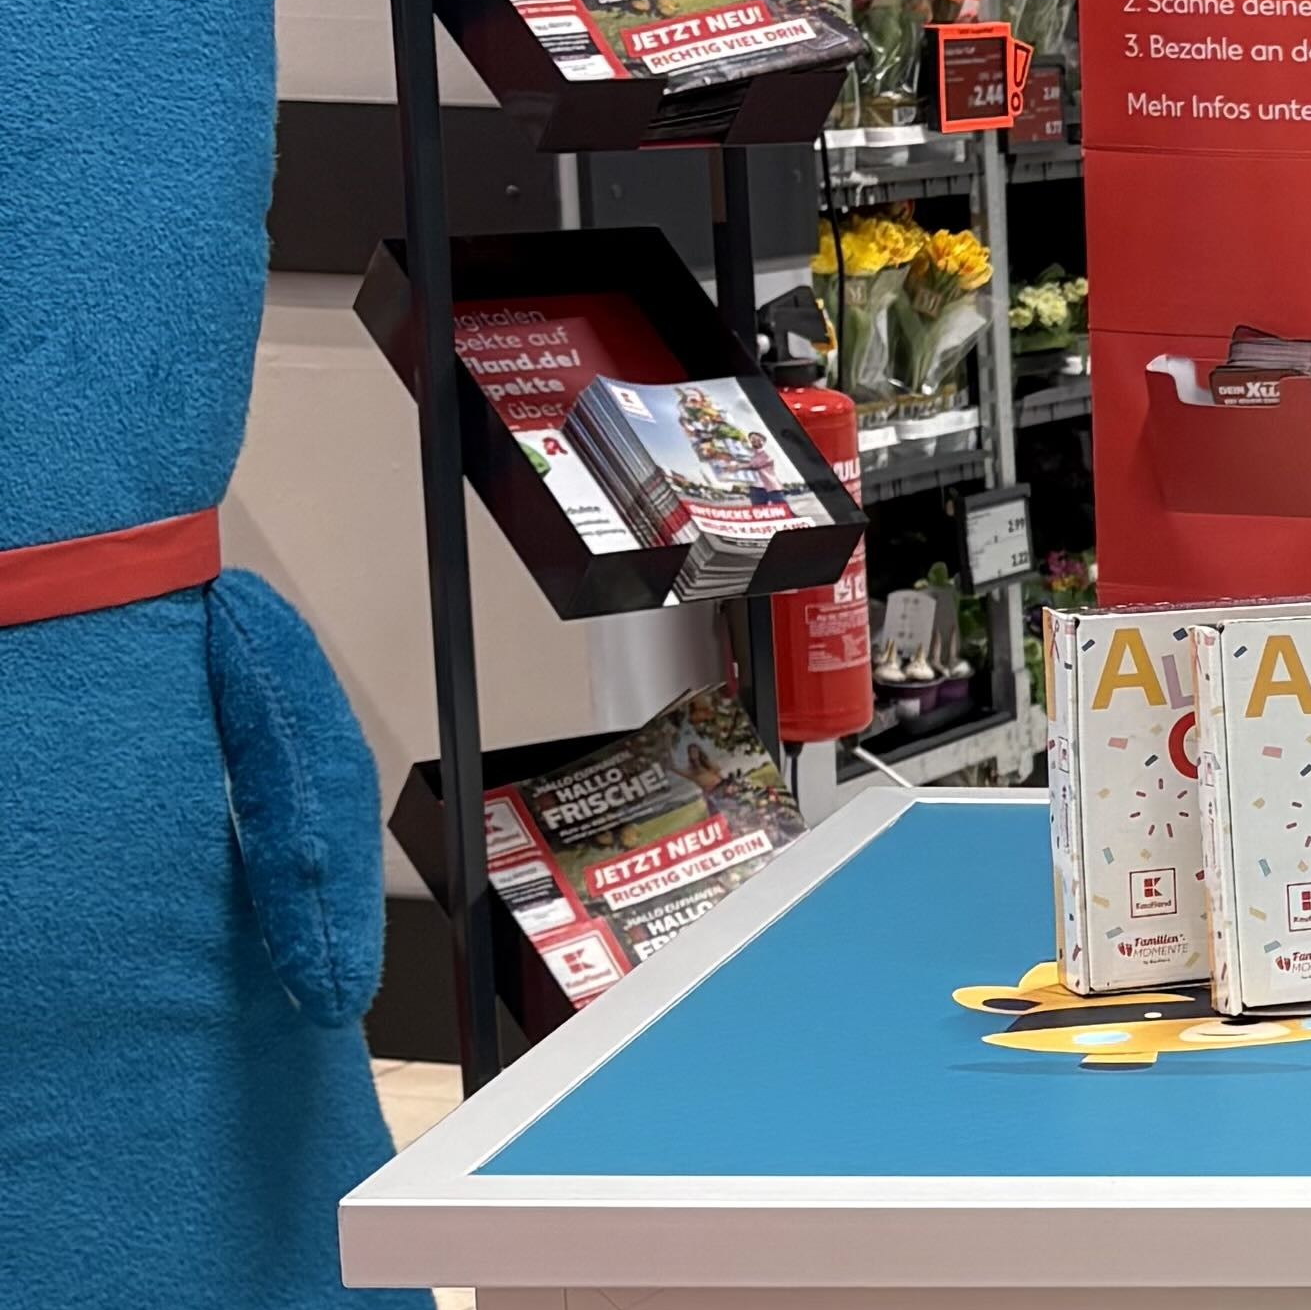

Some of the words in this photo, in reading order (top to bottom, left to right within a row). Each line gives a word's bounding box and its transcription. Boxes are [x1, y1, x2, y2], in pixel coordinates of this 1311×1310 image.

[631, 20, 702, 52] JETZT
[706, 6, 765, 35] NEU!
[649, 41, 721, 69] RICHTIG
[722, 33, 764, 55] VIEL
[765, 22, 809, 45] DRIN
[1124, 34, 1143, 58] 3.
[1150, 35, 1243, 61] Bezahle
[1251, 43, 1283, 62] an
[1127, 92, 1184, 118] Mehr
[1192, 94, 1251, 120] Infos
[528, 326, 568, 346] auf
[508, 399, 564, 420] über
[541, 763, 669, 830] FRISCHE!
[555, 768, 623, 803] HALLO
[594, 847, 661, 889] JETZT
[667, 822, 722, 860] NEU!
[611, 870, 681, 904] RICHTIG
[682, 855, 720, 879] VIEL
[722, 837, 765, 864] DRIN
[1133, 943, 1189, 958] MOMENTE
[1134, 934, 1179, 947] Familien
